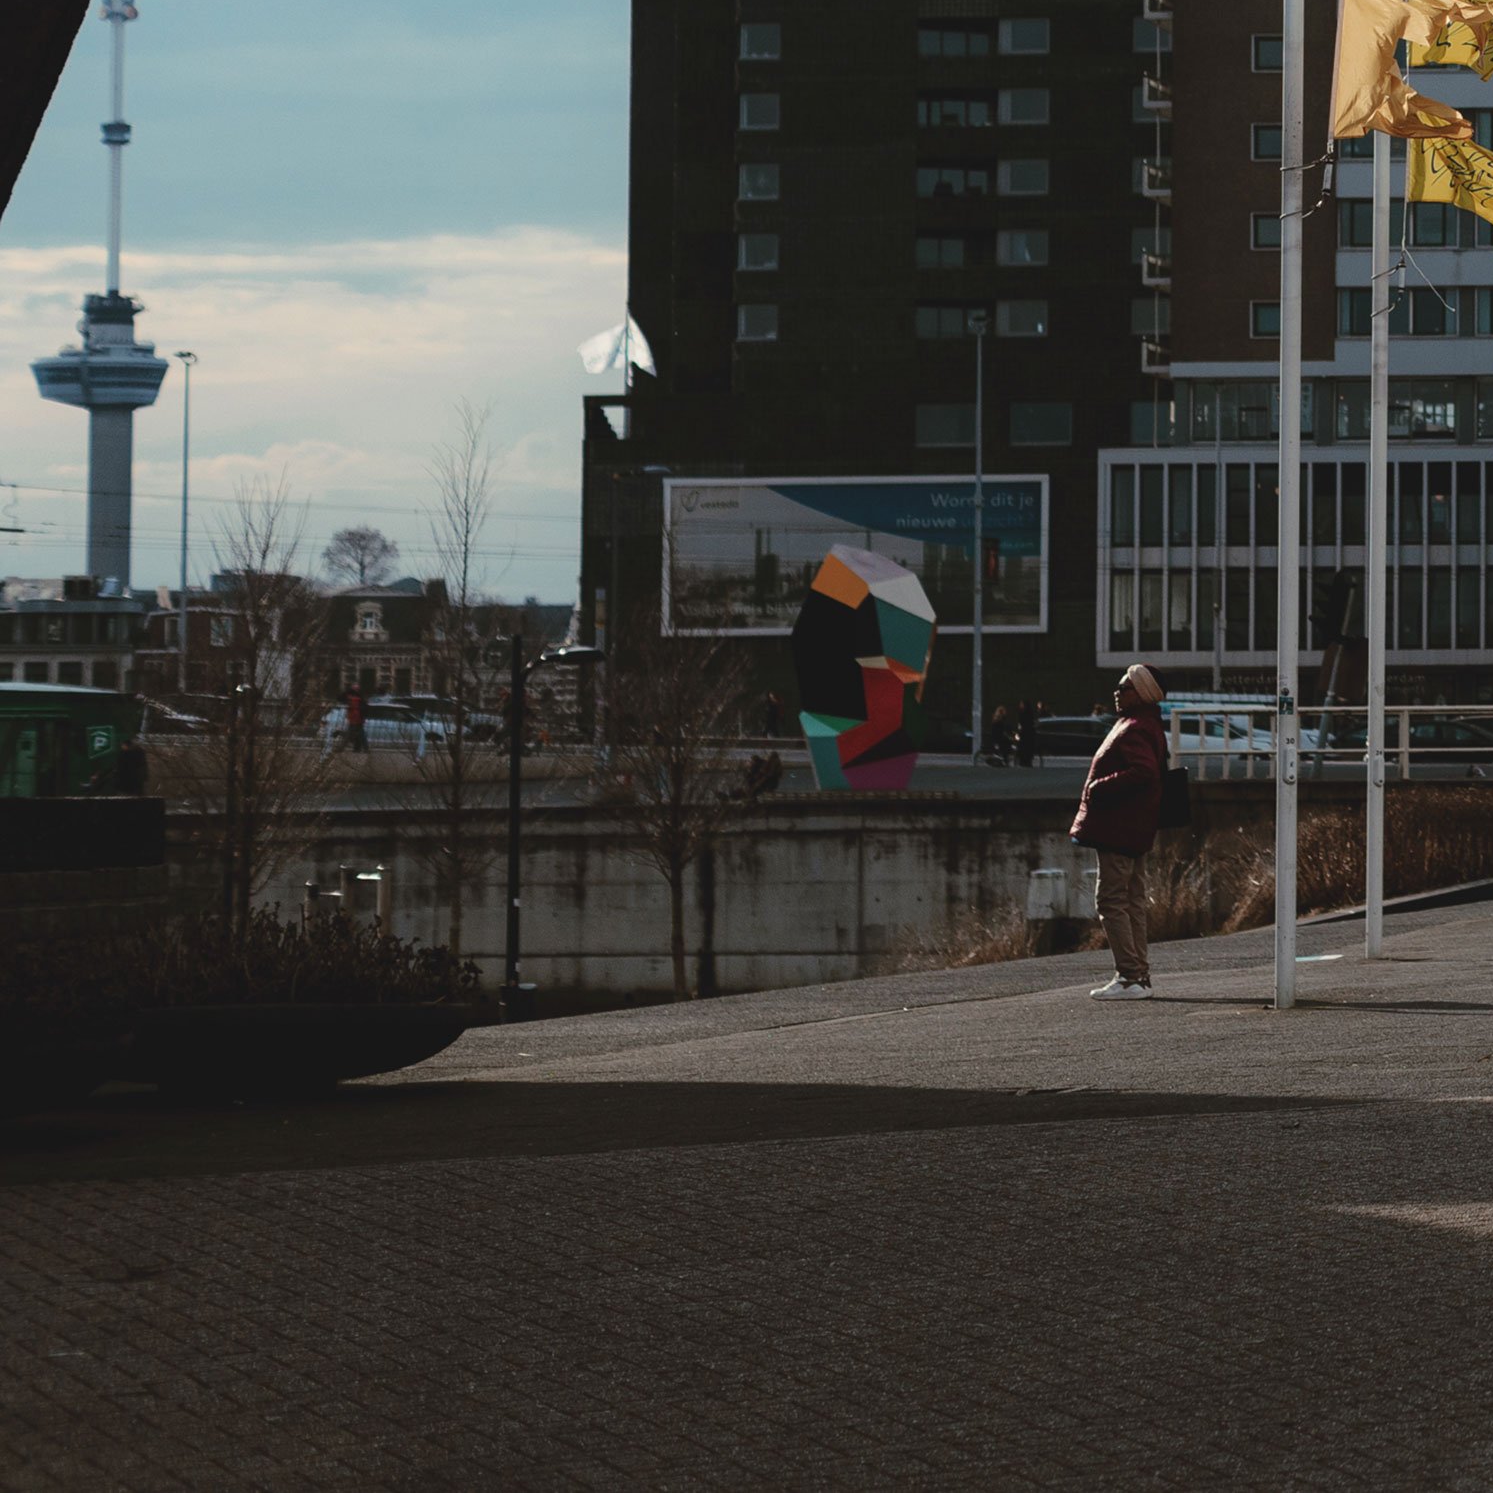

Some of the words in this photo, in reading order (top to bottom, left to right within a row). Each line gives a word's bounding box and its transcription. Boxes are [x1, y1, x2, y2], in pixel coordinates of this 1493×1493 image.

[990, 492, 1013, 507] dit
[1017, 493, 1034, 510] je
[896, 514, 956, 528] nieuwe
